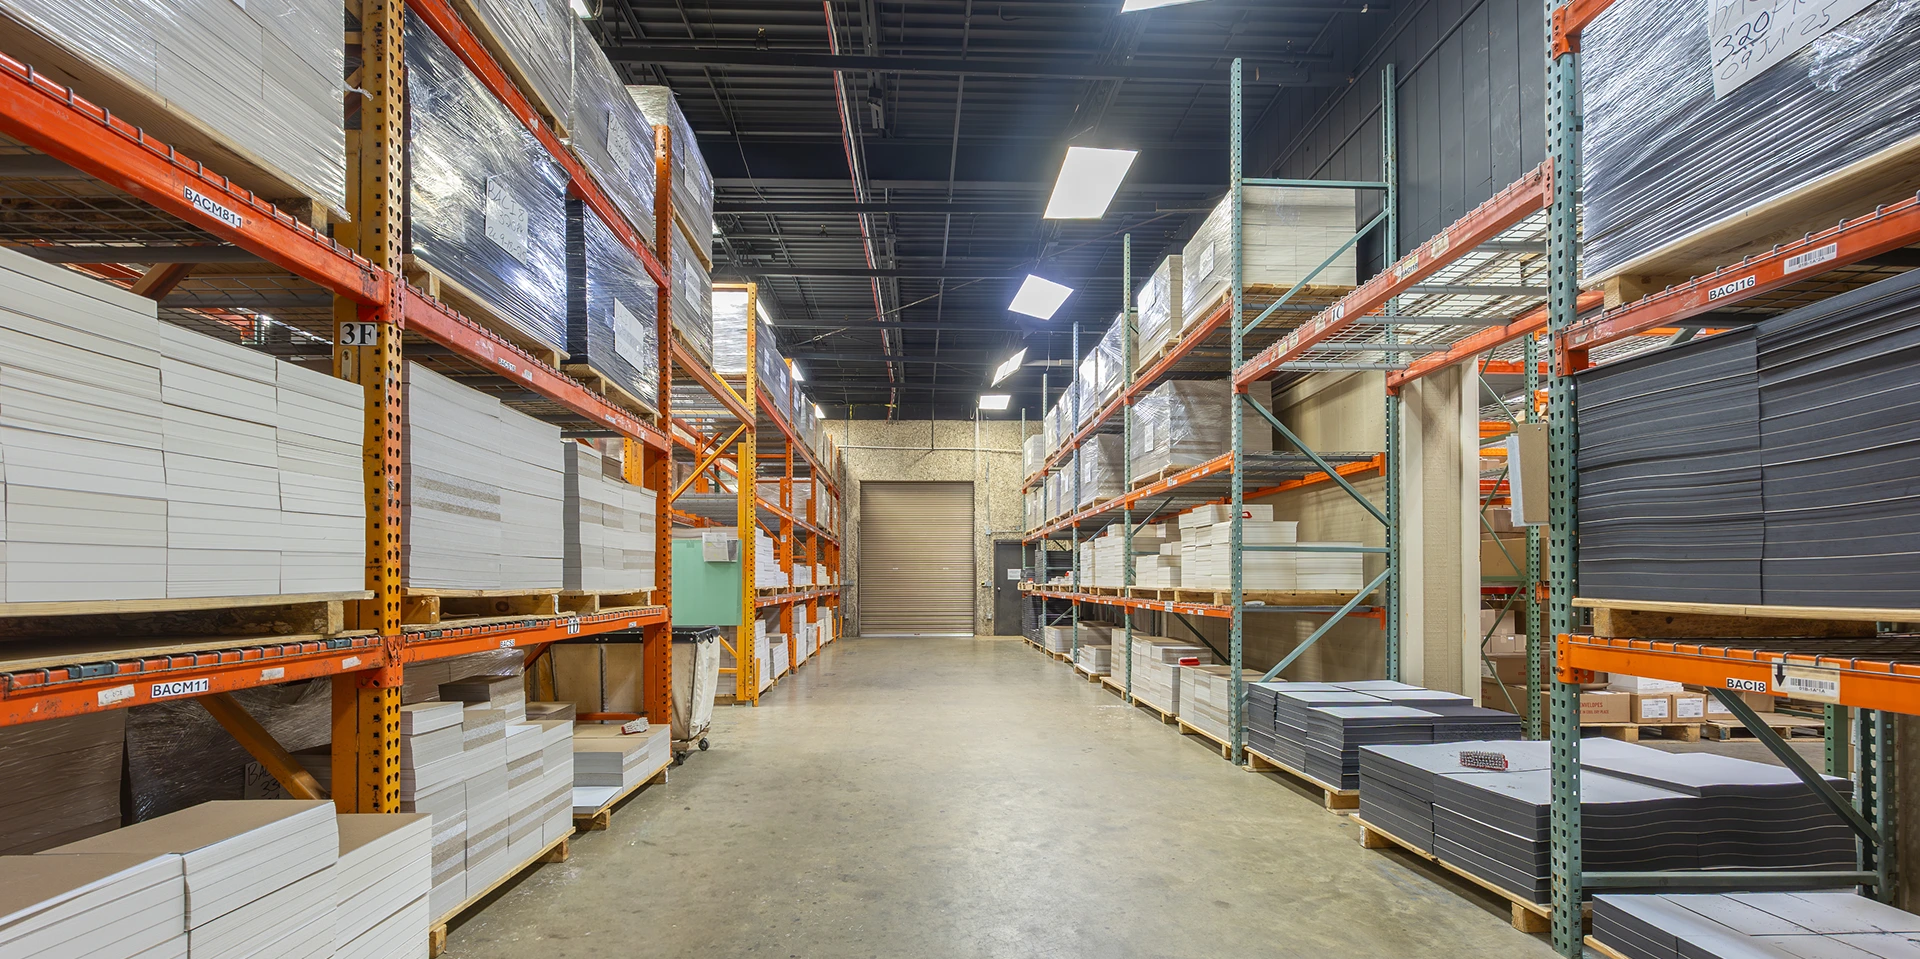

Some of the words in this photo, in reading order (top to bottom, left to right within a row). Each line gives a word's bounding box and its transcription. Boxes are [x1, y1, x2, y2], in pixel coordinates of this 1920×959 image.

[185, 188, 242, 228] BACM811
[1709, 276, 1755, 299] BACI16
[341, 322, 376, 345] 3F
[153, 680, 208, 697] BACM11
[1726, 678, 1767, 693] BACI8
